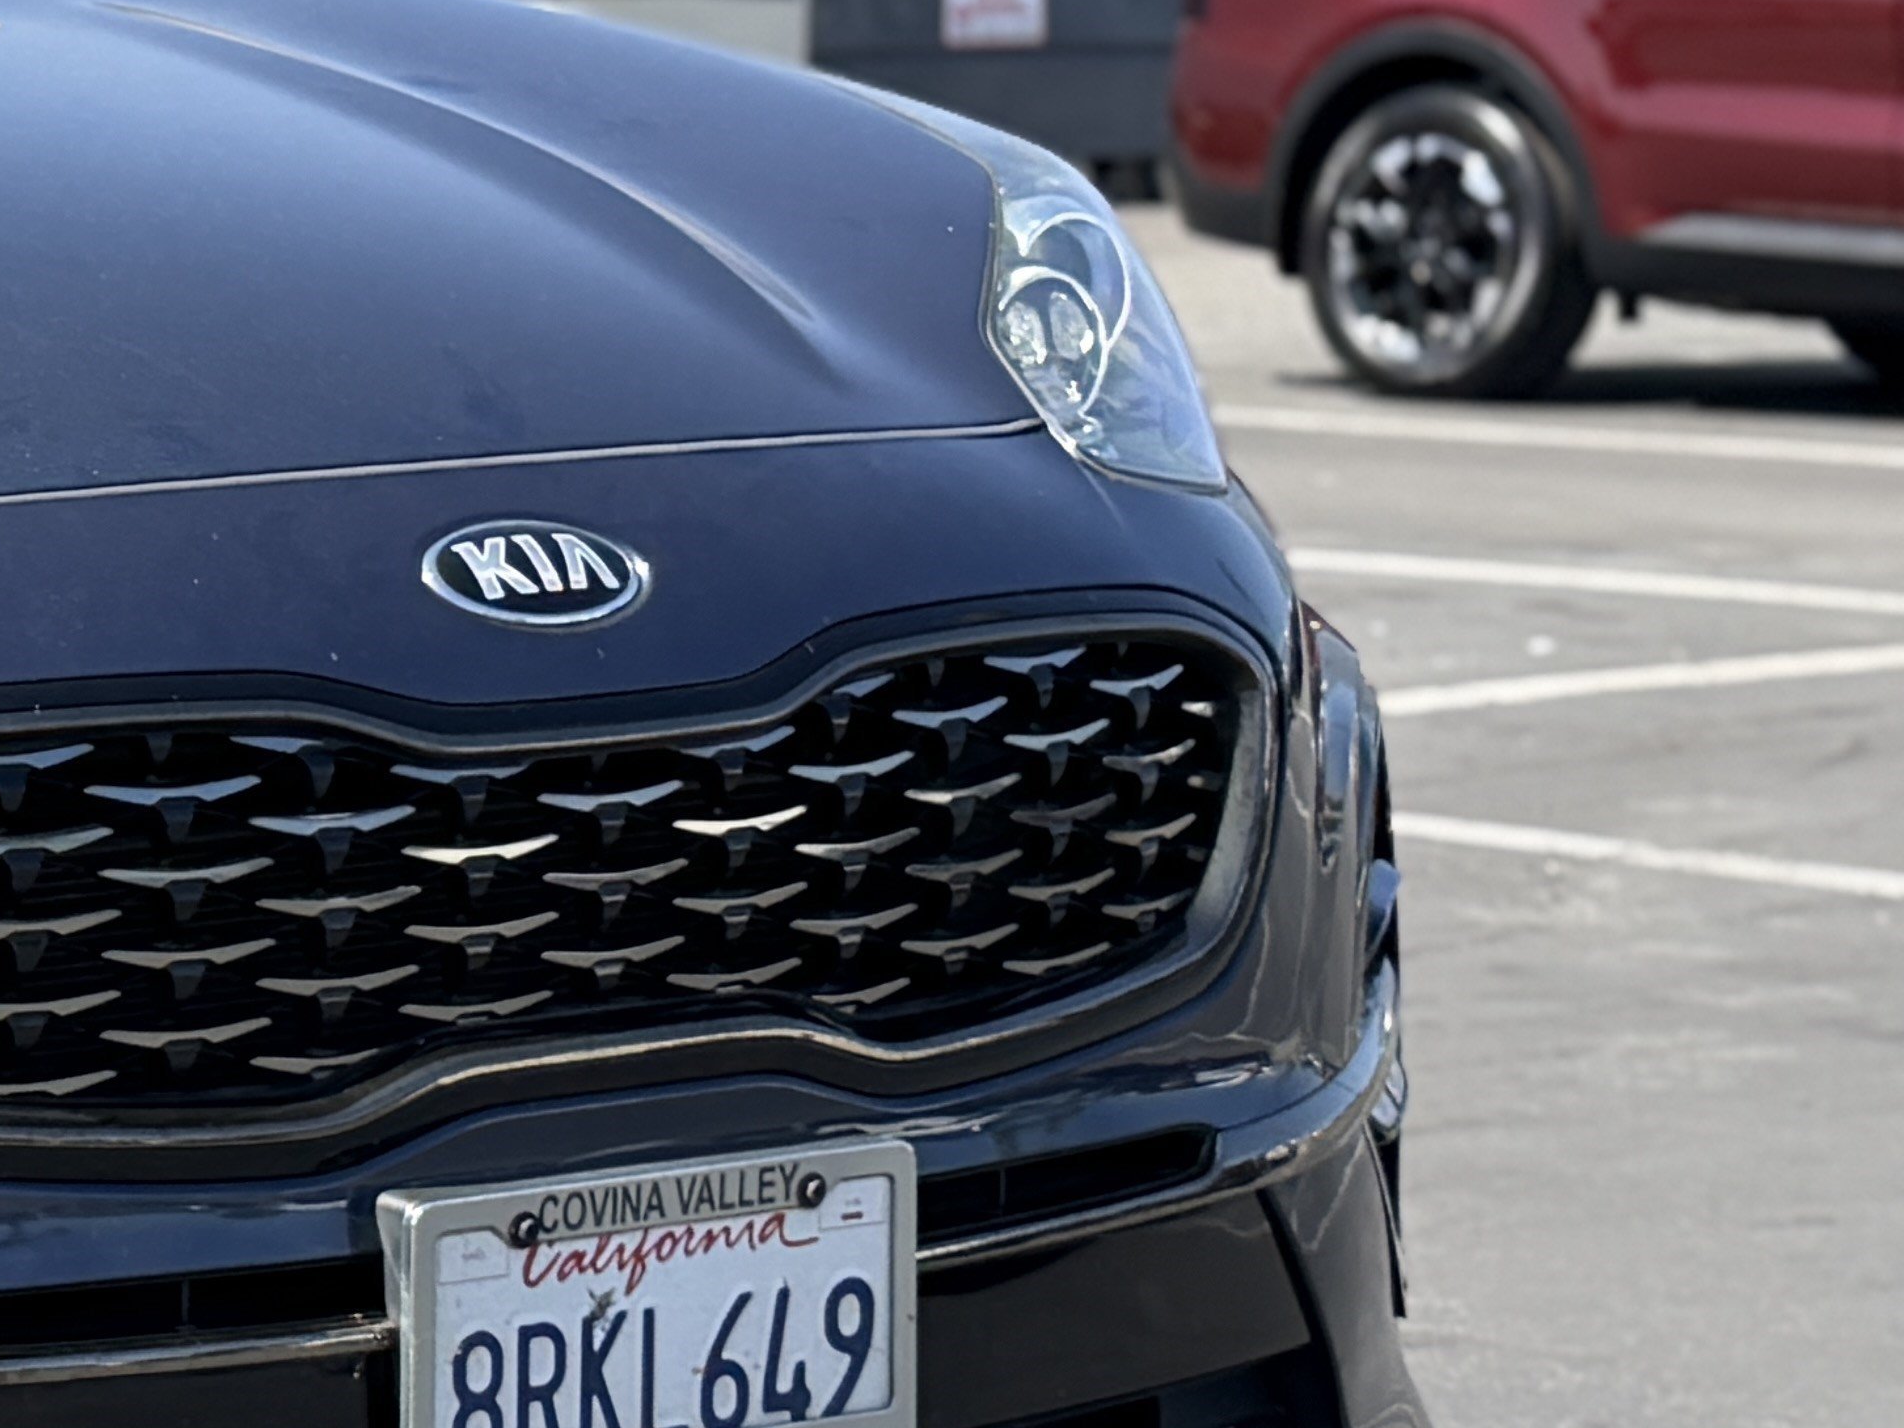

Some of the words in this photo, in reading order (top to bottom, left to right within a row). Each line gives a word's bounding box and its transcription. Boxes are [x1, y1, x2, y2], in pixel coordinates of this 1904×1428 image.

[450, 532, 621, 600] KIA
[538, 1180, 666, 1234] COVINA
[676, 1163, 800, 1216] VALLEY
[522, 1211, 820, 1296] California
